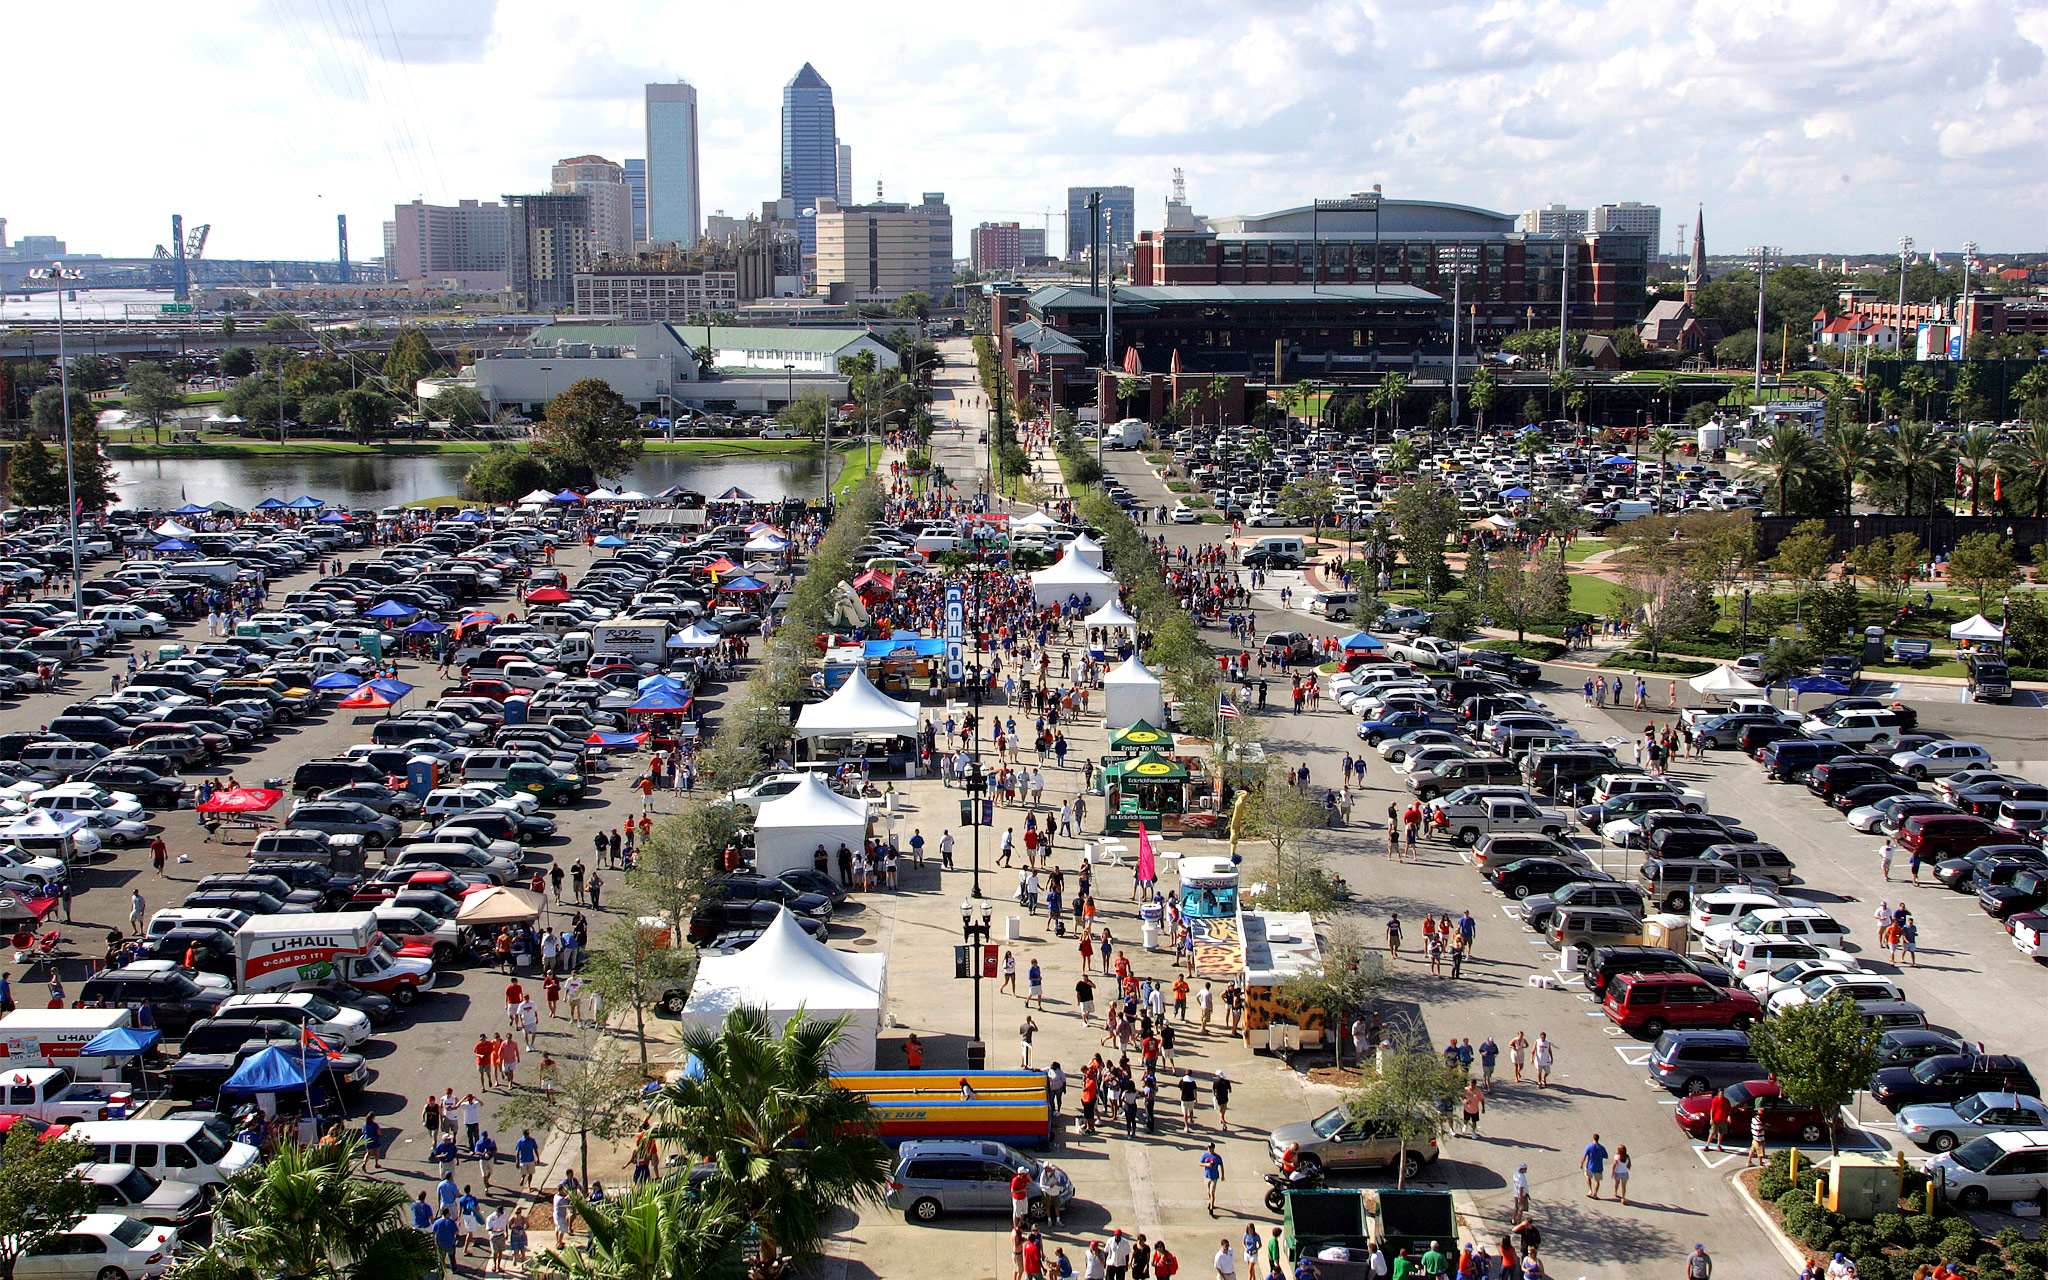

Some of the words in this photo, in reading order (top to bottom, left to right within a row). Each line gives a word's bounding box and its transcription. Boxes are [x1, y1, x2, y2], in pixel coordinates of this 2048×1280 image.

[605, 629, 642, 637] RSVP
[272, 936, 339, 952] U-HAUL
[294, 953, 307, 961] DO
[57, 1034, 98, 1042] U-HAU
[895, 1111, 927, 1119] RUN
[242, 1134, 251, 1144] 15
